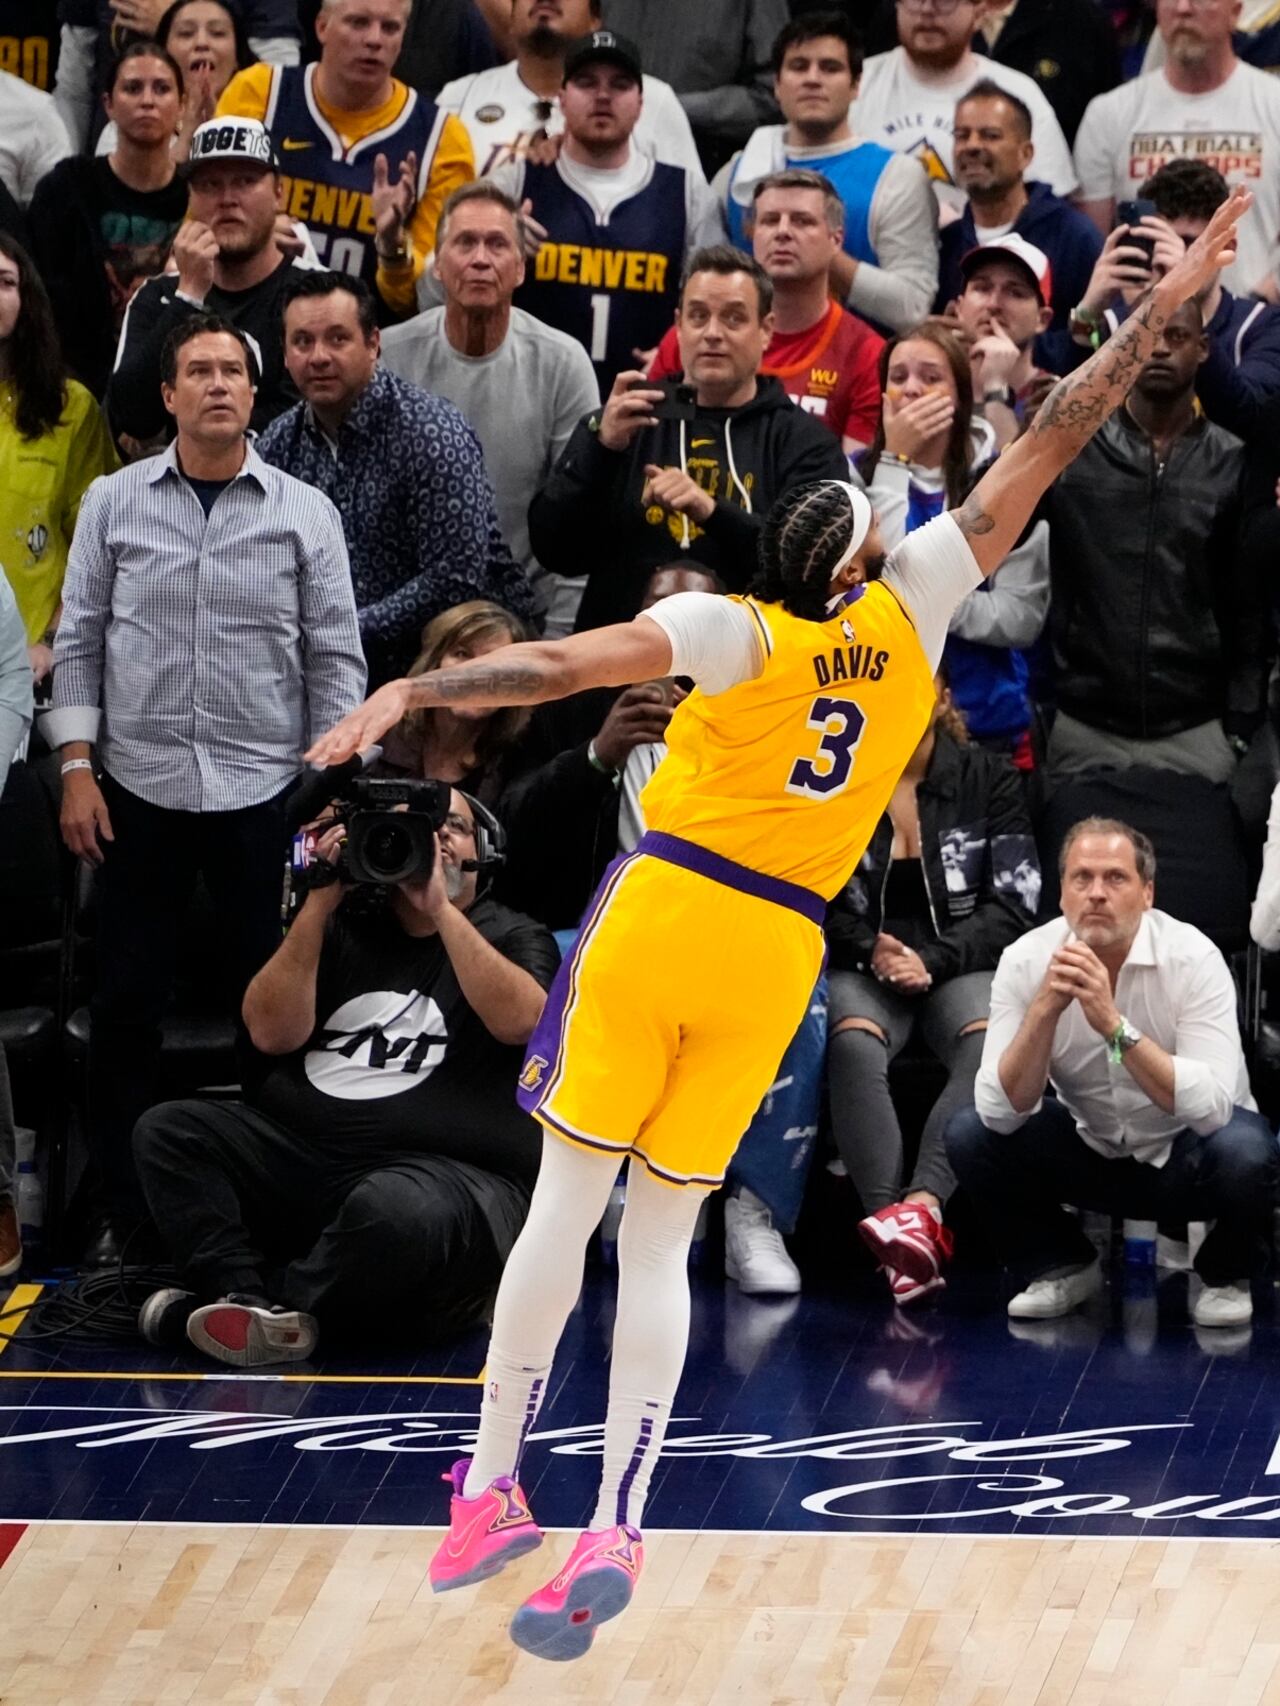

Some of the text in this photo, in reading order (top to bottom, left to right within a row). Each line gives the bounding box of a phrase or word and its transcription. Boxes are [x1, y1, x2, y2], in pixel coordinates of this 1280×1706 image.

[535, 242, 669, 293] DENVER
[591, 294, 611, 362] 1
[811, 367, 837, 385] WU
[812, 644, 889, 687] DAVIS
[783, 695, 868, 802] 3
